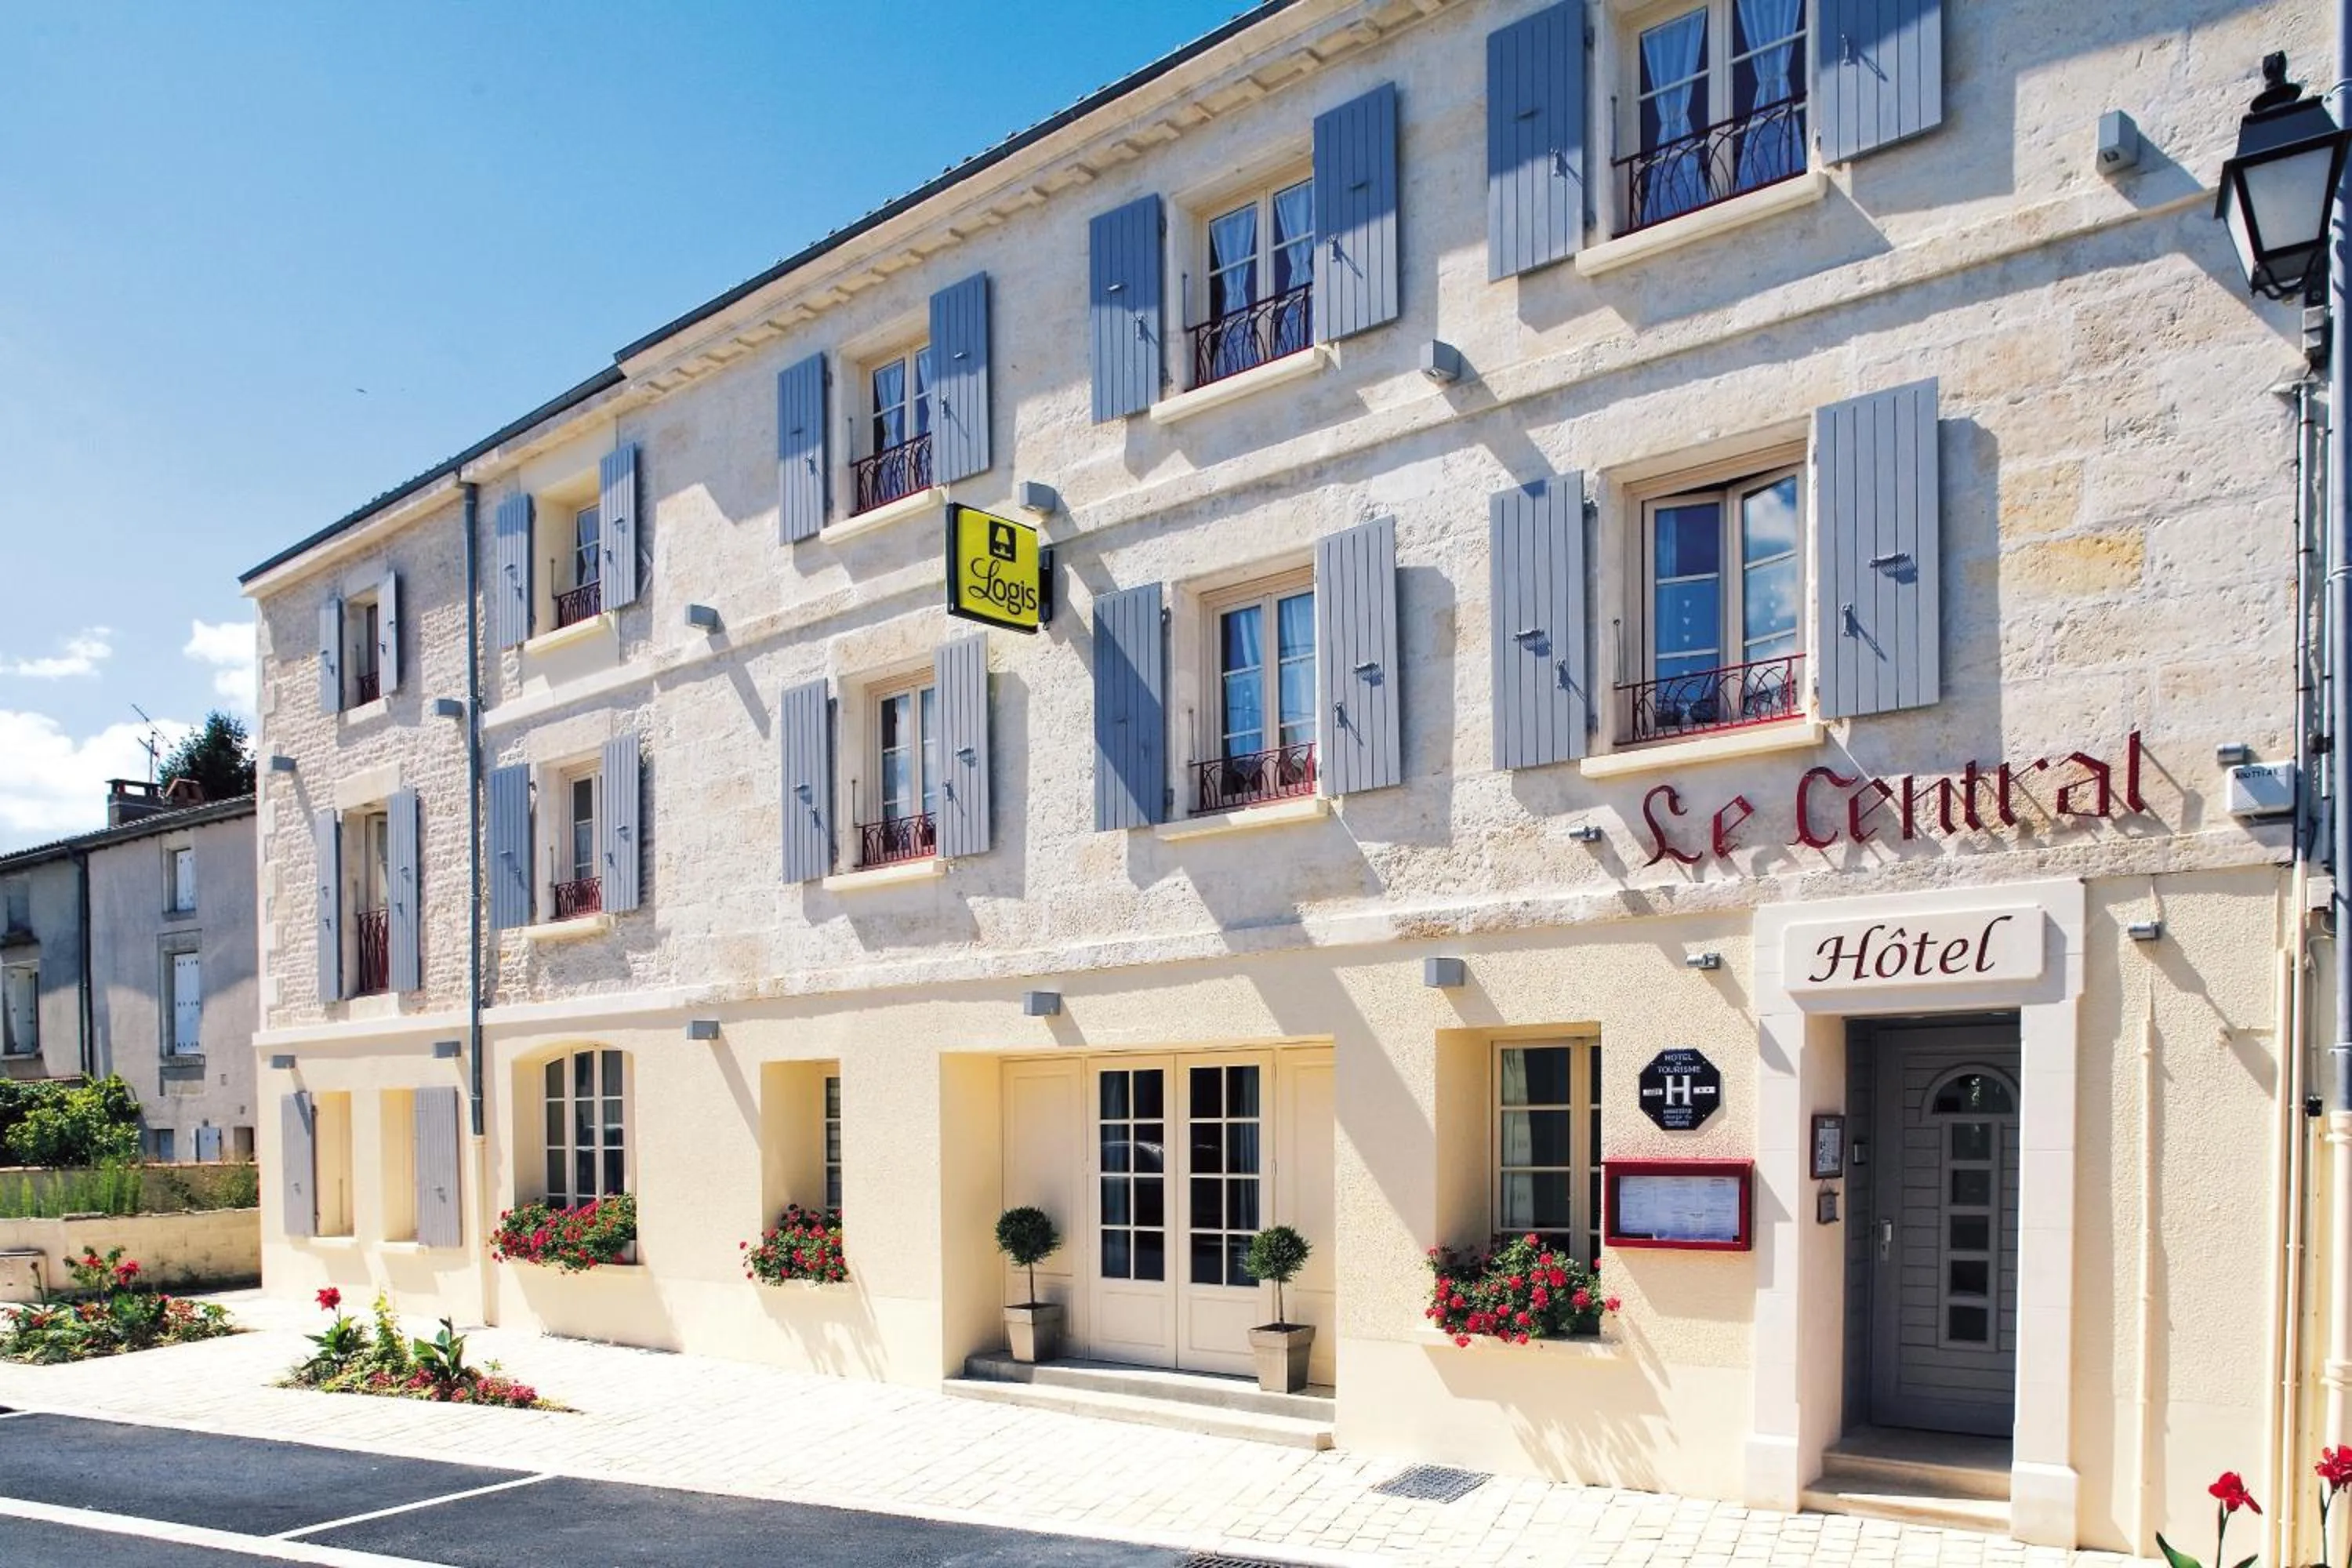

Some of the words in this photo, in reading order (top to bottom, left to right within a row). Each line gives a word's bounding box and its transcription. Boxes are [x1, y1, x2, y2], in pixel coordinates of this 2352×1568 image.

[968, 557, 1036, 615] Logis
[1641, 784, 1755, 868] Le
[1788, 730, 2148, 850] Central
[1808, 914, 2013, 984] Hôtel
[1665, 1075, 1693, 1105] H
